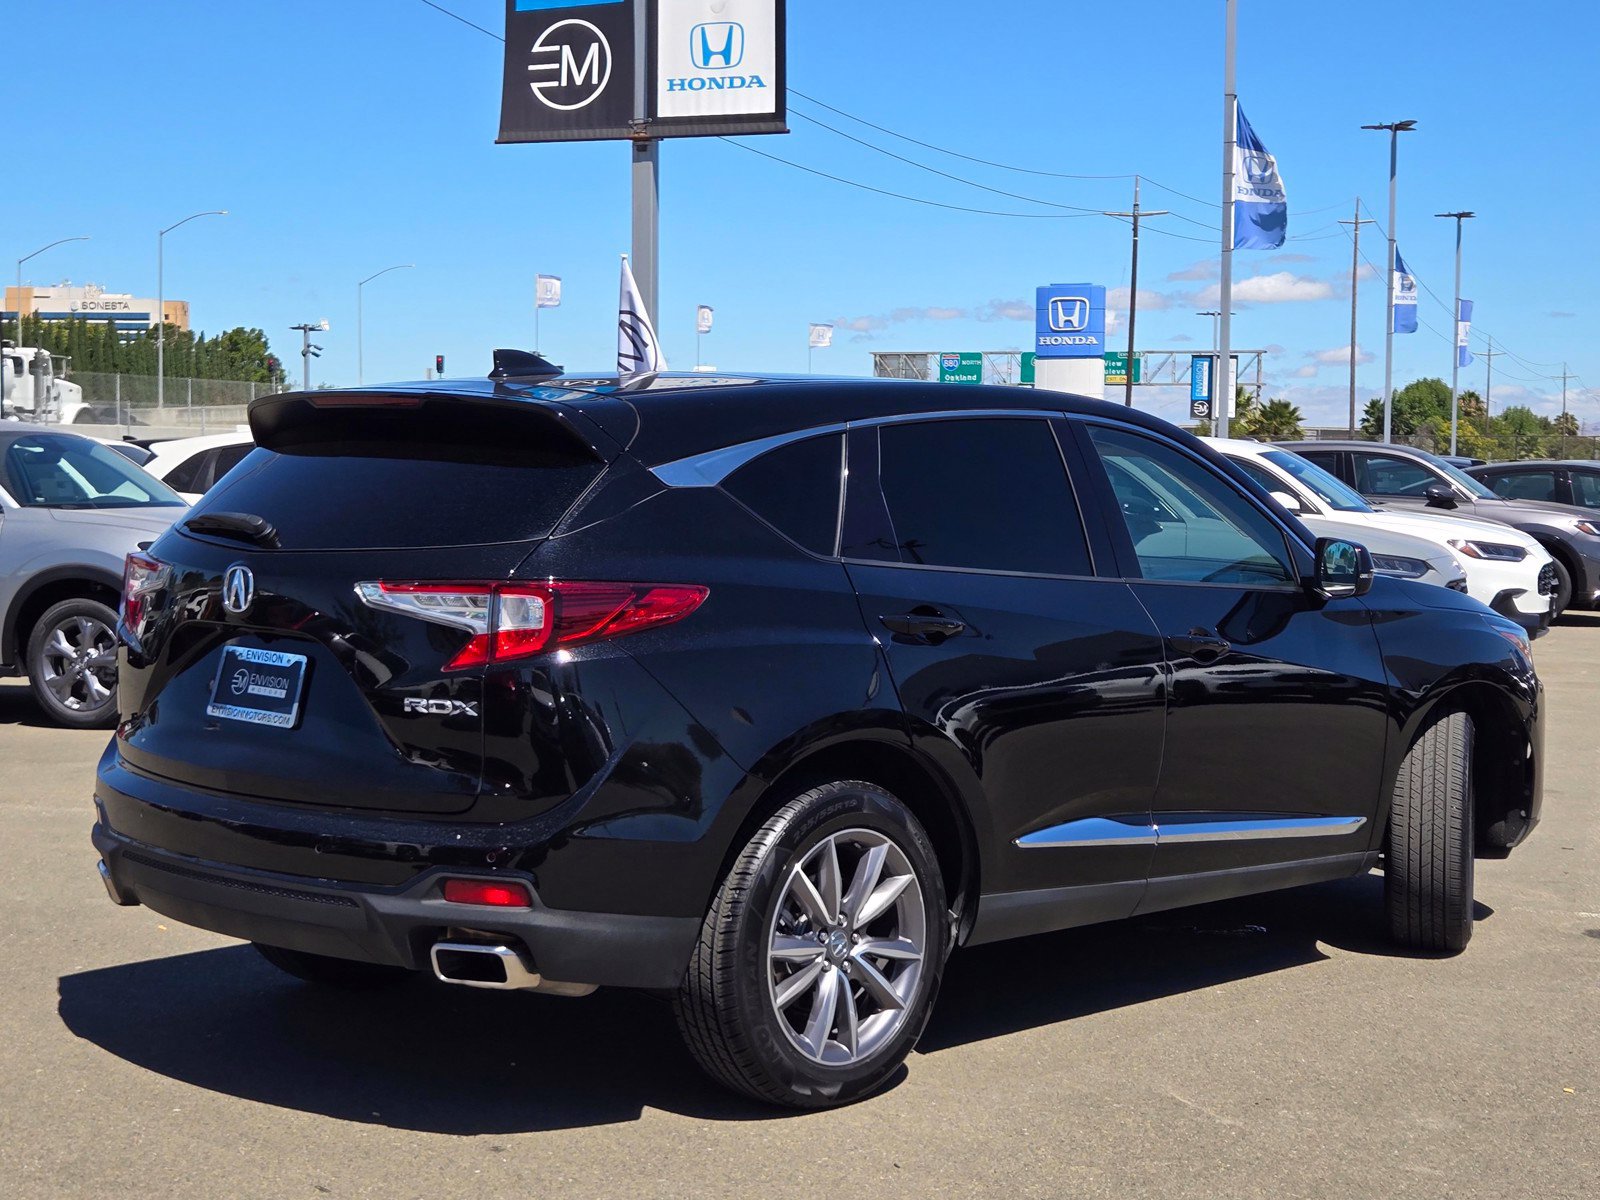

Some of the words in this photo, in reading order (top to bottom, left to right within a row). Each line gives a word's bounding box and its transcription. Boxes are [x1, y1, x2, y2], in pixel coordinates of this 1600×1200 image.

[667, 75, 767, 92] HONDA
[81, 301, 130, 311] SONESTA
[1038, 335, 1099, 346] HONDA
[944, 374, 977, 382] Oakland
[1195, 360, 1204, 397] ENVISION
[245, 649, 284, 664] ENVISION
[249, 673, 290, 690] ENVISION
[211, 704, 291, 726] ENVISIONMOTORS.COM
[404, 697, 478, 716] RDX
